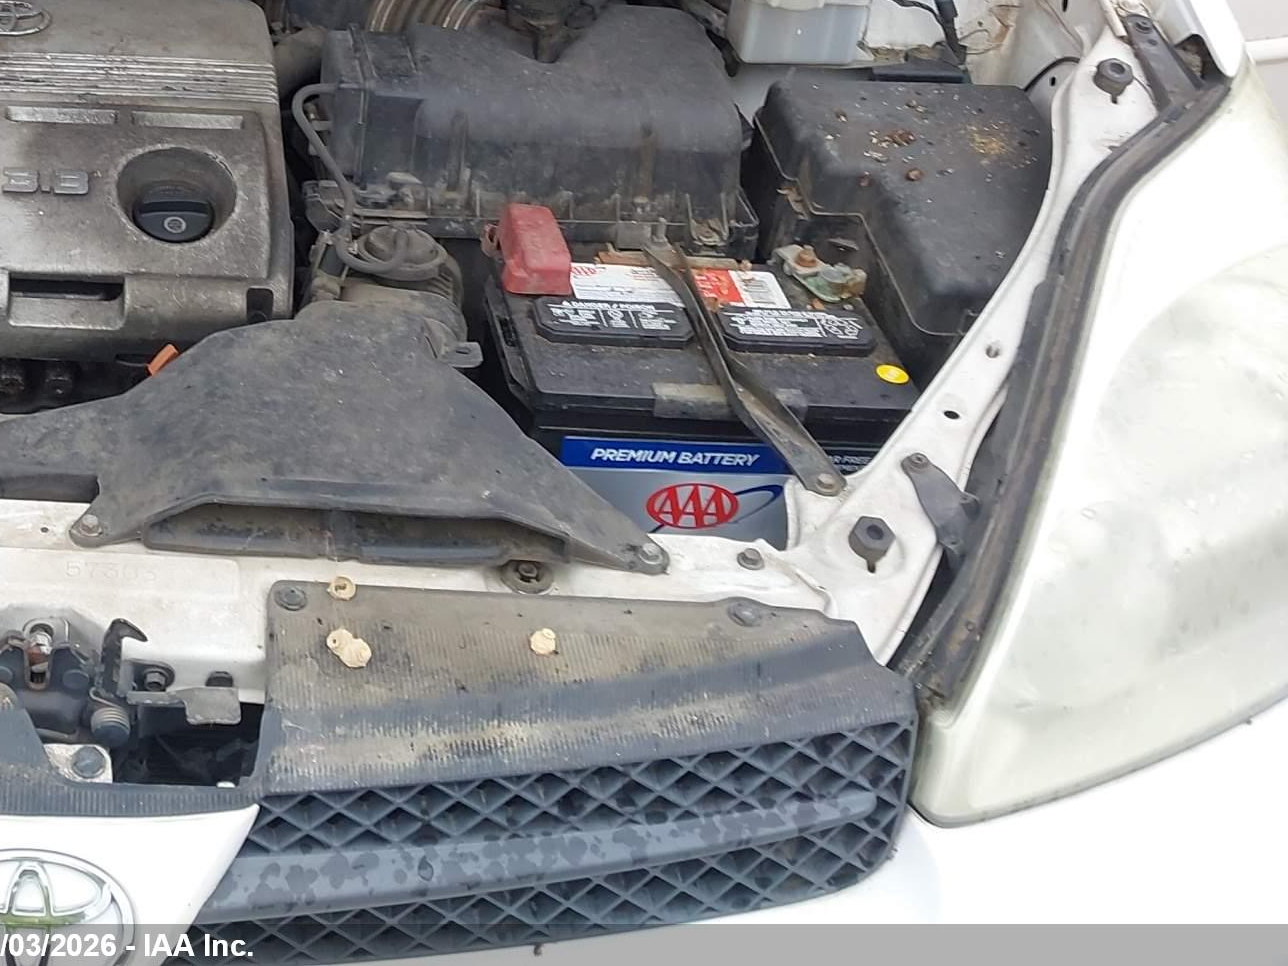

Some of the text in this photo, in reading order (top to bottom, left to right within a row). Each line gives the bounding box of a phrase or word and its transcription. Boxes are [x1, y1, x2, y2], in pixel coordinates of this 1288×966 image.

[1, 167, 90, 196] 3.3
[590, 447, 761, 467] PREMIUM BATTERY
[653, 483, 732, 529] AAA
